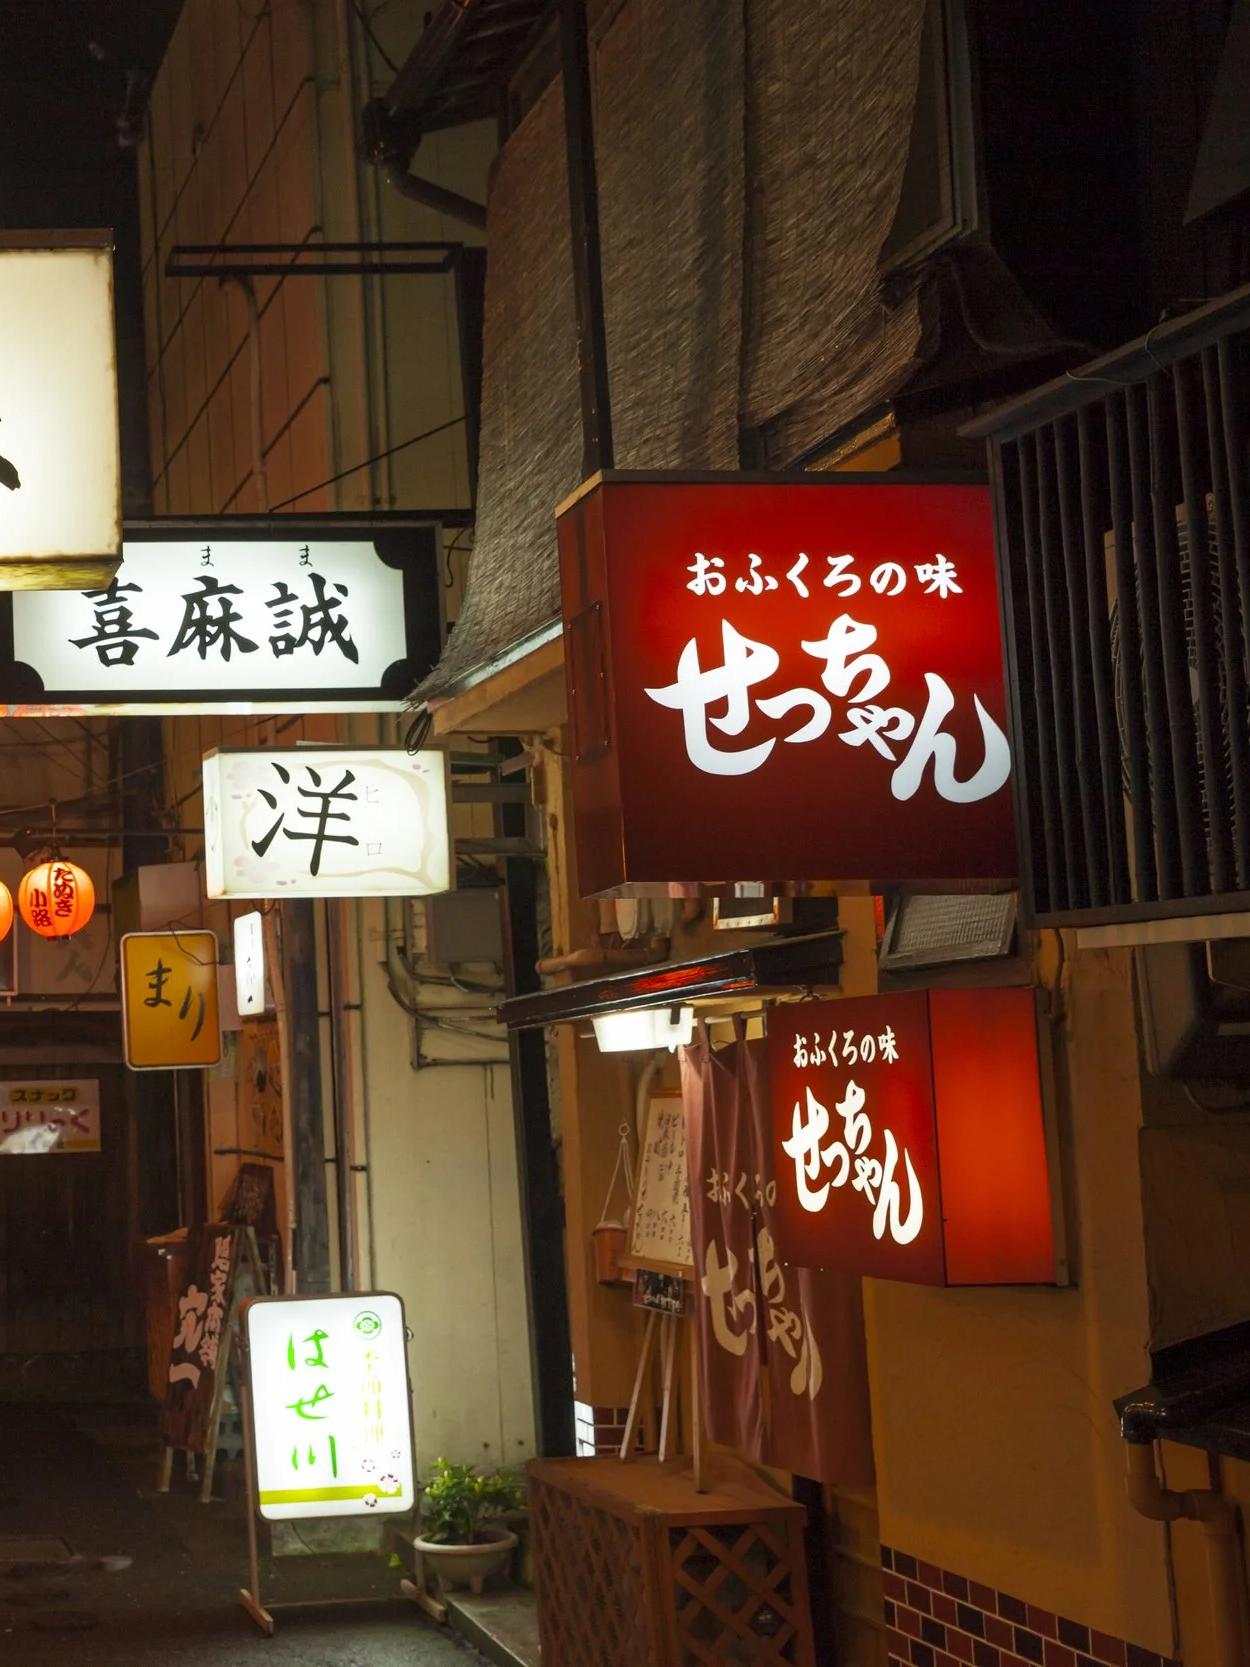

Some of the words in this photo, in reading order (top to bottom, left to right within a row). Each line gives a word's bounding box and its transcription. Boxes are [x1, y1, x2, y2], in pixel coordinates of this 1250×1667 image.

[200, 545, 215, 568] ま
[299, 544, 313, 568] ま
[686, 552, 964, 599] おふくろの味
[68, 572, 360, 668] 喜麻誠
[643, 612, 1011, 804] せっちゃん
[250, 761, 360, 878] 洋
[30, 888, 52, 927] 小路
[53, 868, 74, 917] たぬき
[143, 958, 205, 1042] まり
[792, 1024, 899, 1068] おふくろの味
[11, 1087, 77, 1103] スナック
[781, 1078, 924, 1245] せっちゃん
[285, 1329, 337, 1478] はせ川
